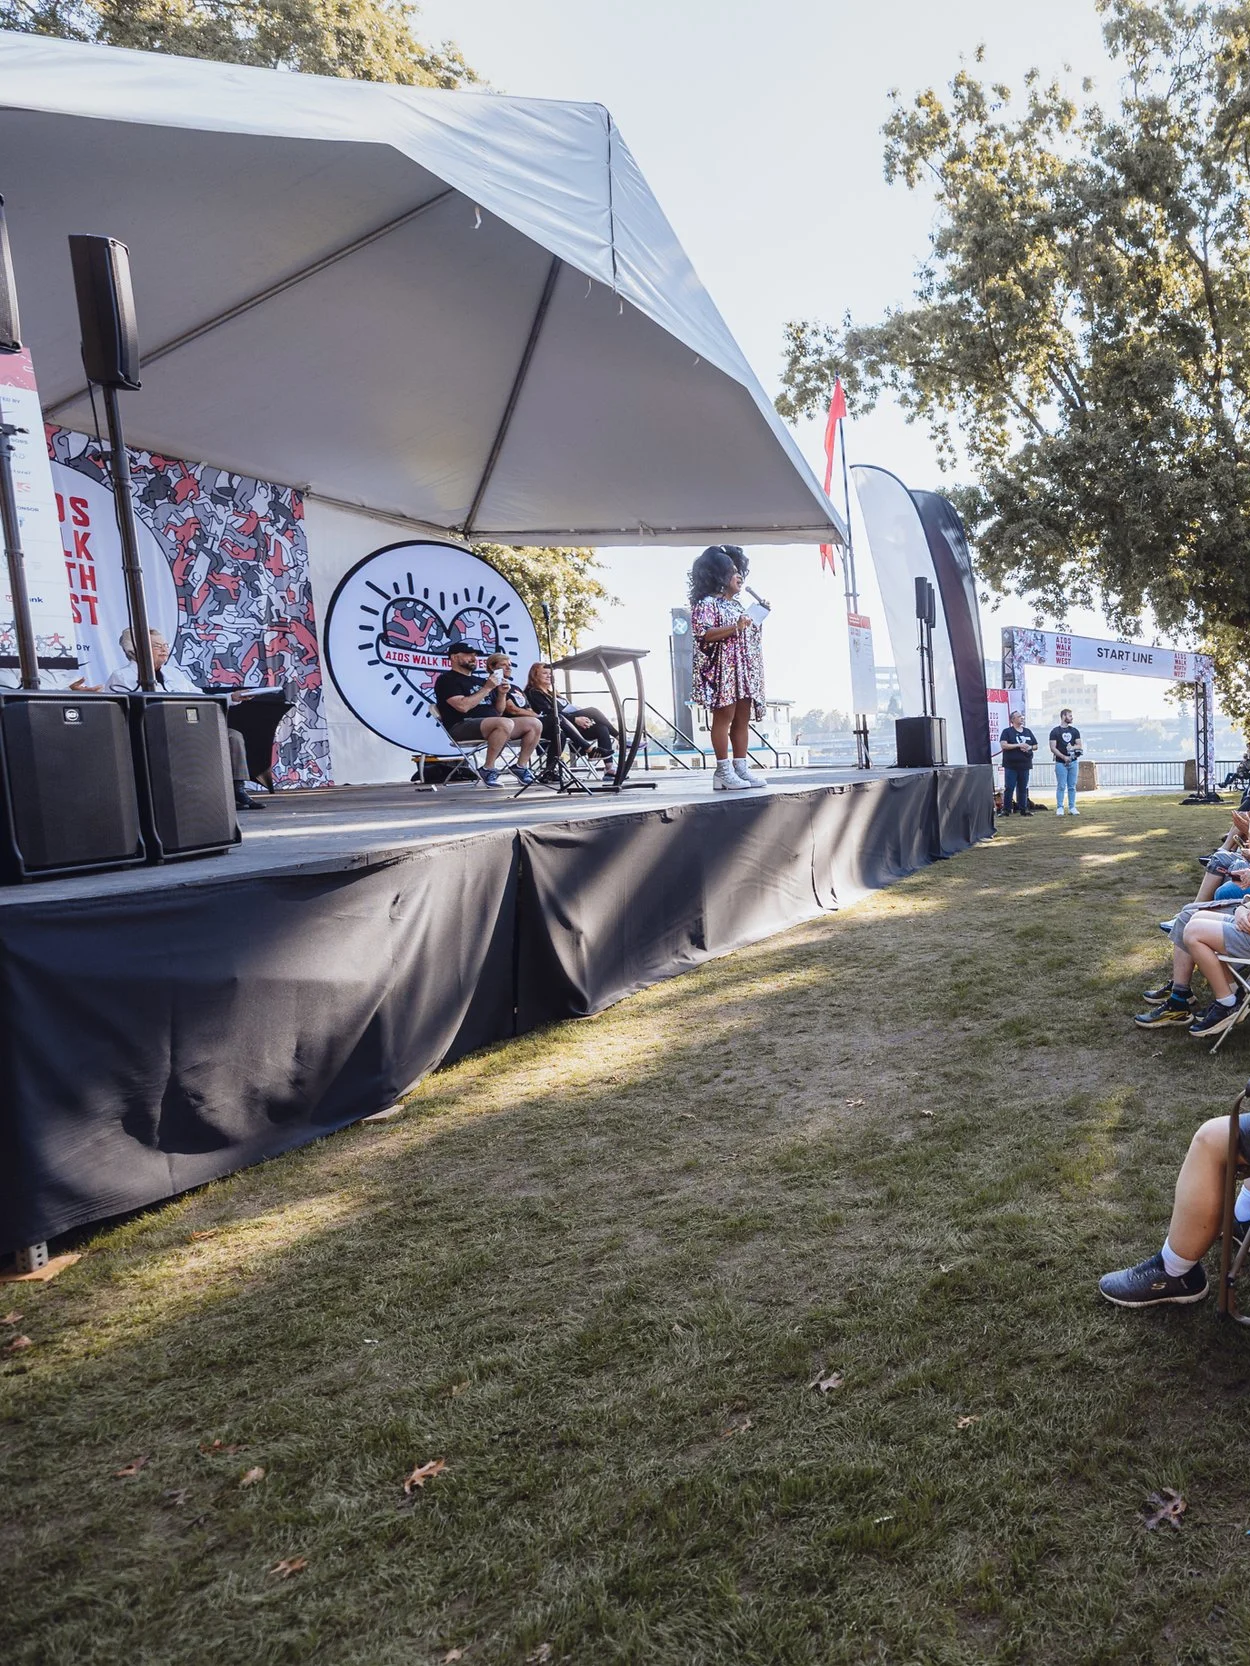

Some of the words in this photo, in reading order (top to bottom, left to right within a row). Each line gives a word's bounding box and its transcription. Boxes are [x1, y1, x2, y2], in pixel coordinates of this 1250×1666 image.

[1055, 636, 1071, 645] AIDS
[1055, 643, 1071, 651] WALK
[385, 651, 409, 663] AIDS
[412, 654, 439, 666] WALK
[1097, 647, 1130, 662] START
[1132, 651, 1153, 664] LINE
